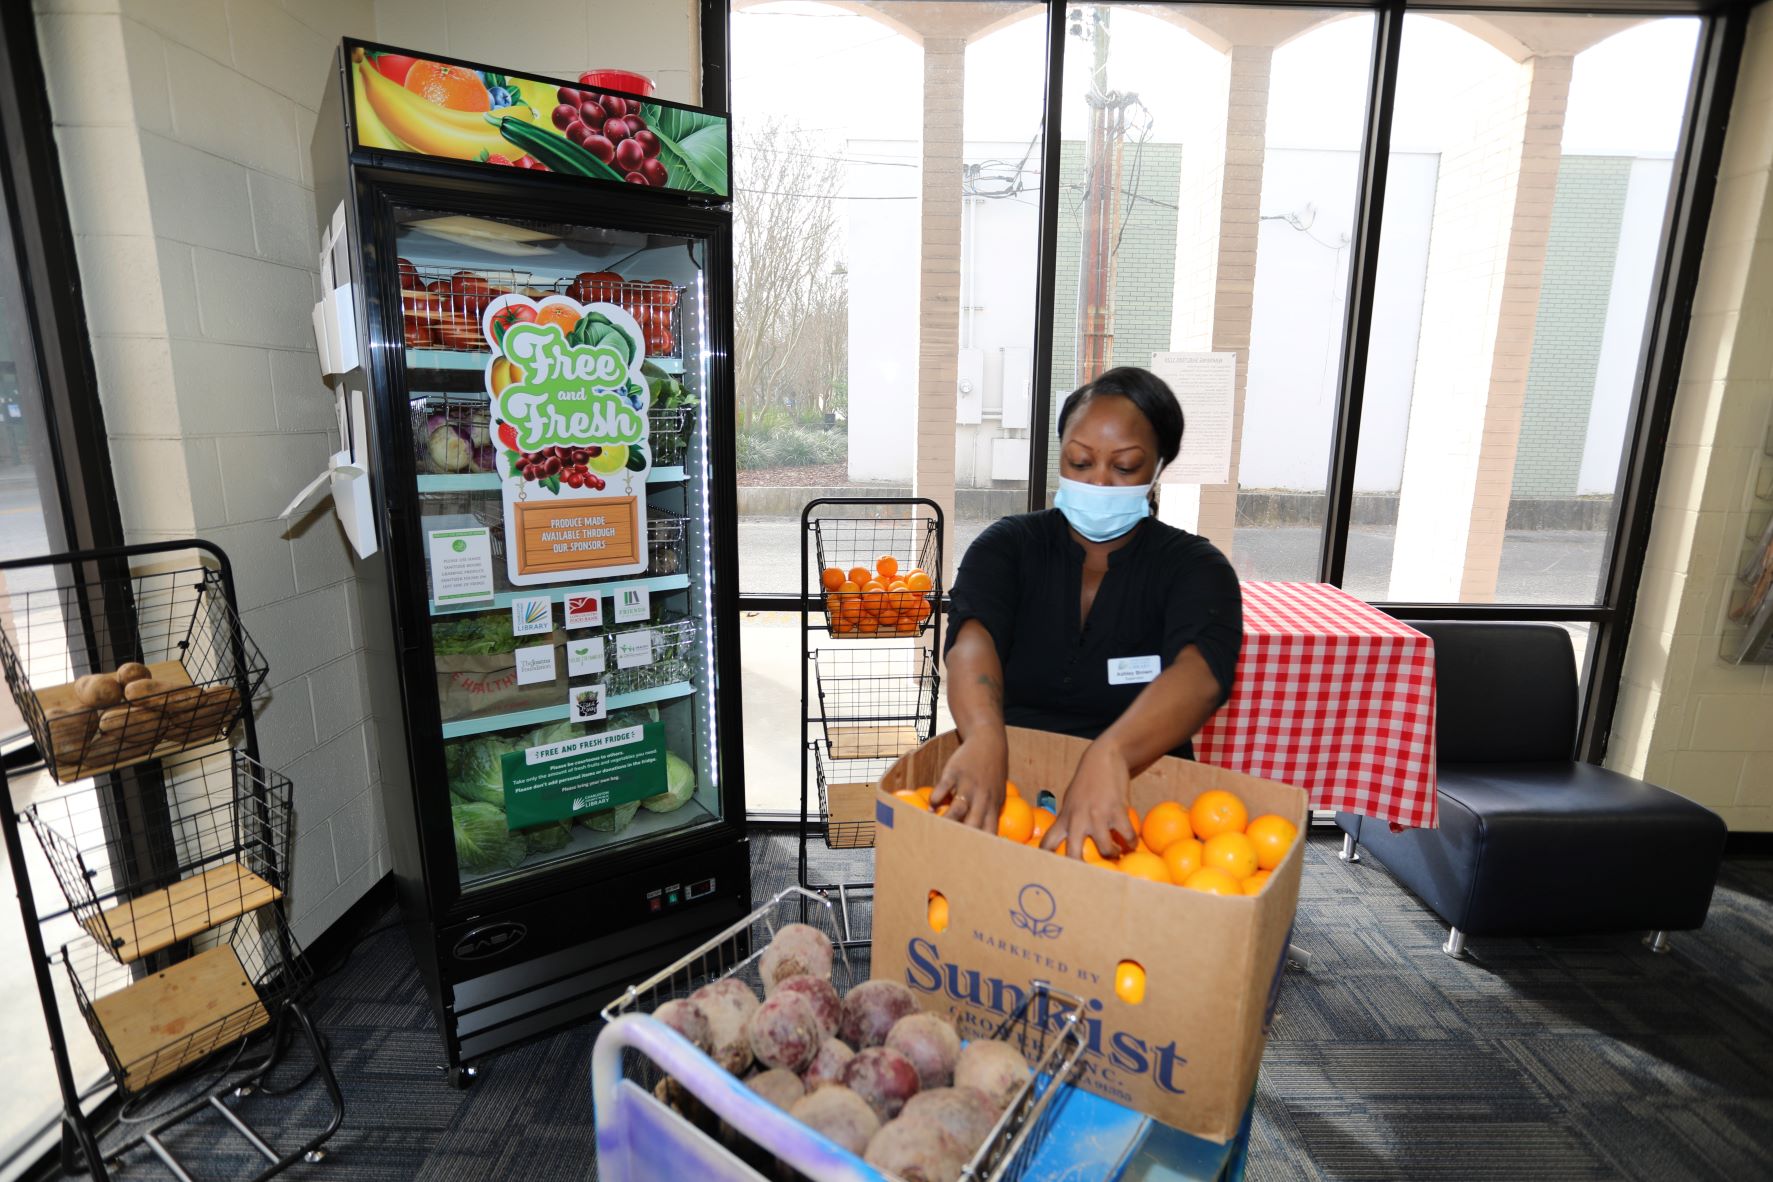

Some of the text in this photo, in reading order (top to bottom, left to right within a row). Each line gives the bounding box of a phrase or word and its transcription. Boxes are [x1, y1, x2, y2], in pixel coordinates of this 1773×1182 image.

[513, 331, 620, 385] Free
[557, 387, 588, 400] and
[507, 392, 637, 444] Fresh
[551, 516, 606, 528] PRODUCE MADE
[542, 528, 616, 542] AVAILABLE THROUGH
[553, 540, 606, 553] OUR SPONSORS
[518, 623, 548, 632] LIBRARY
[541, 733, 630, 757] FREE AND FRESH FRIDGE
[574, 756, 600, 765] courteous
[610, 755, 635, 764] vegetables
[558, 774, 581, 784] personal
[602, 764, 627, 773] donations
[585, 798, 610, 808] LIBRARY
[973, 929, 1100, 985] MARKETED BY
[905, 937, 1188, 1094] Sunkist
